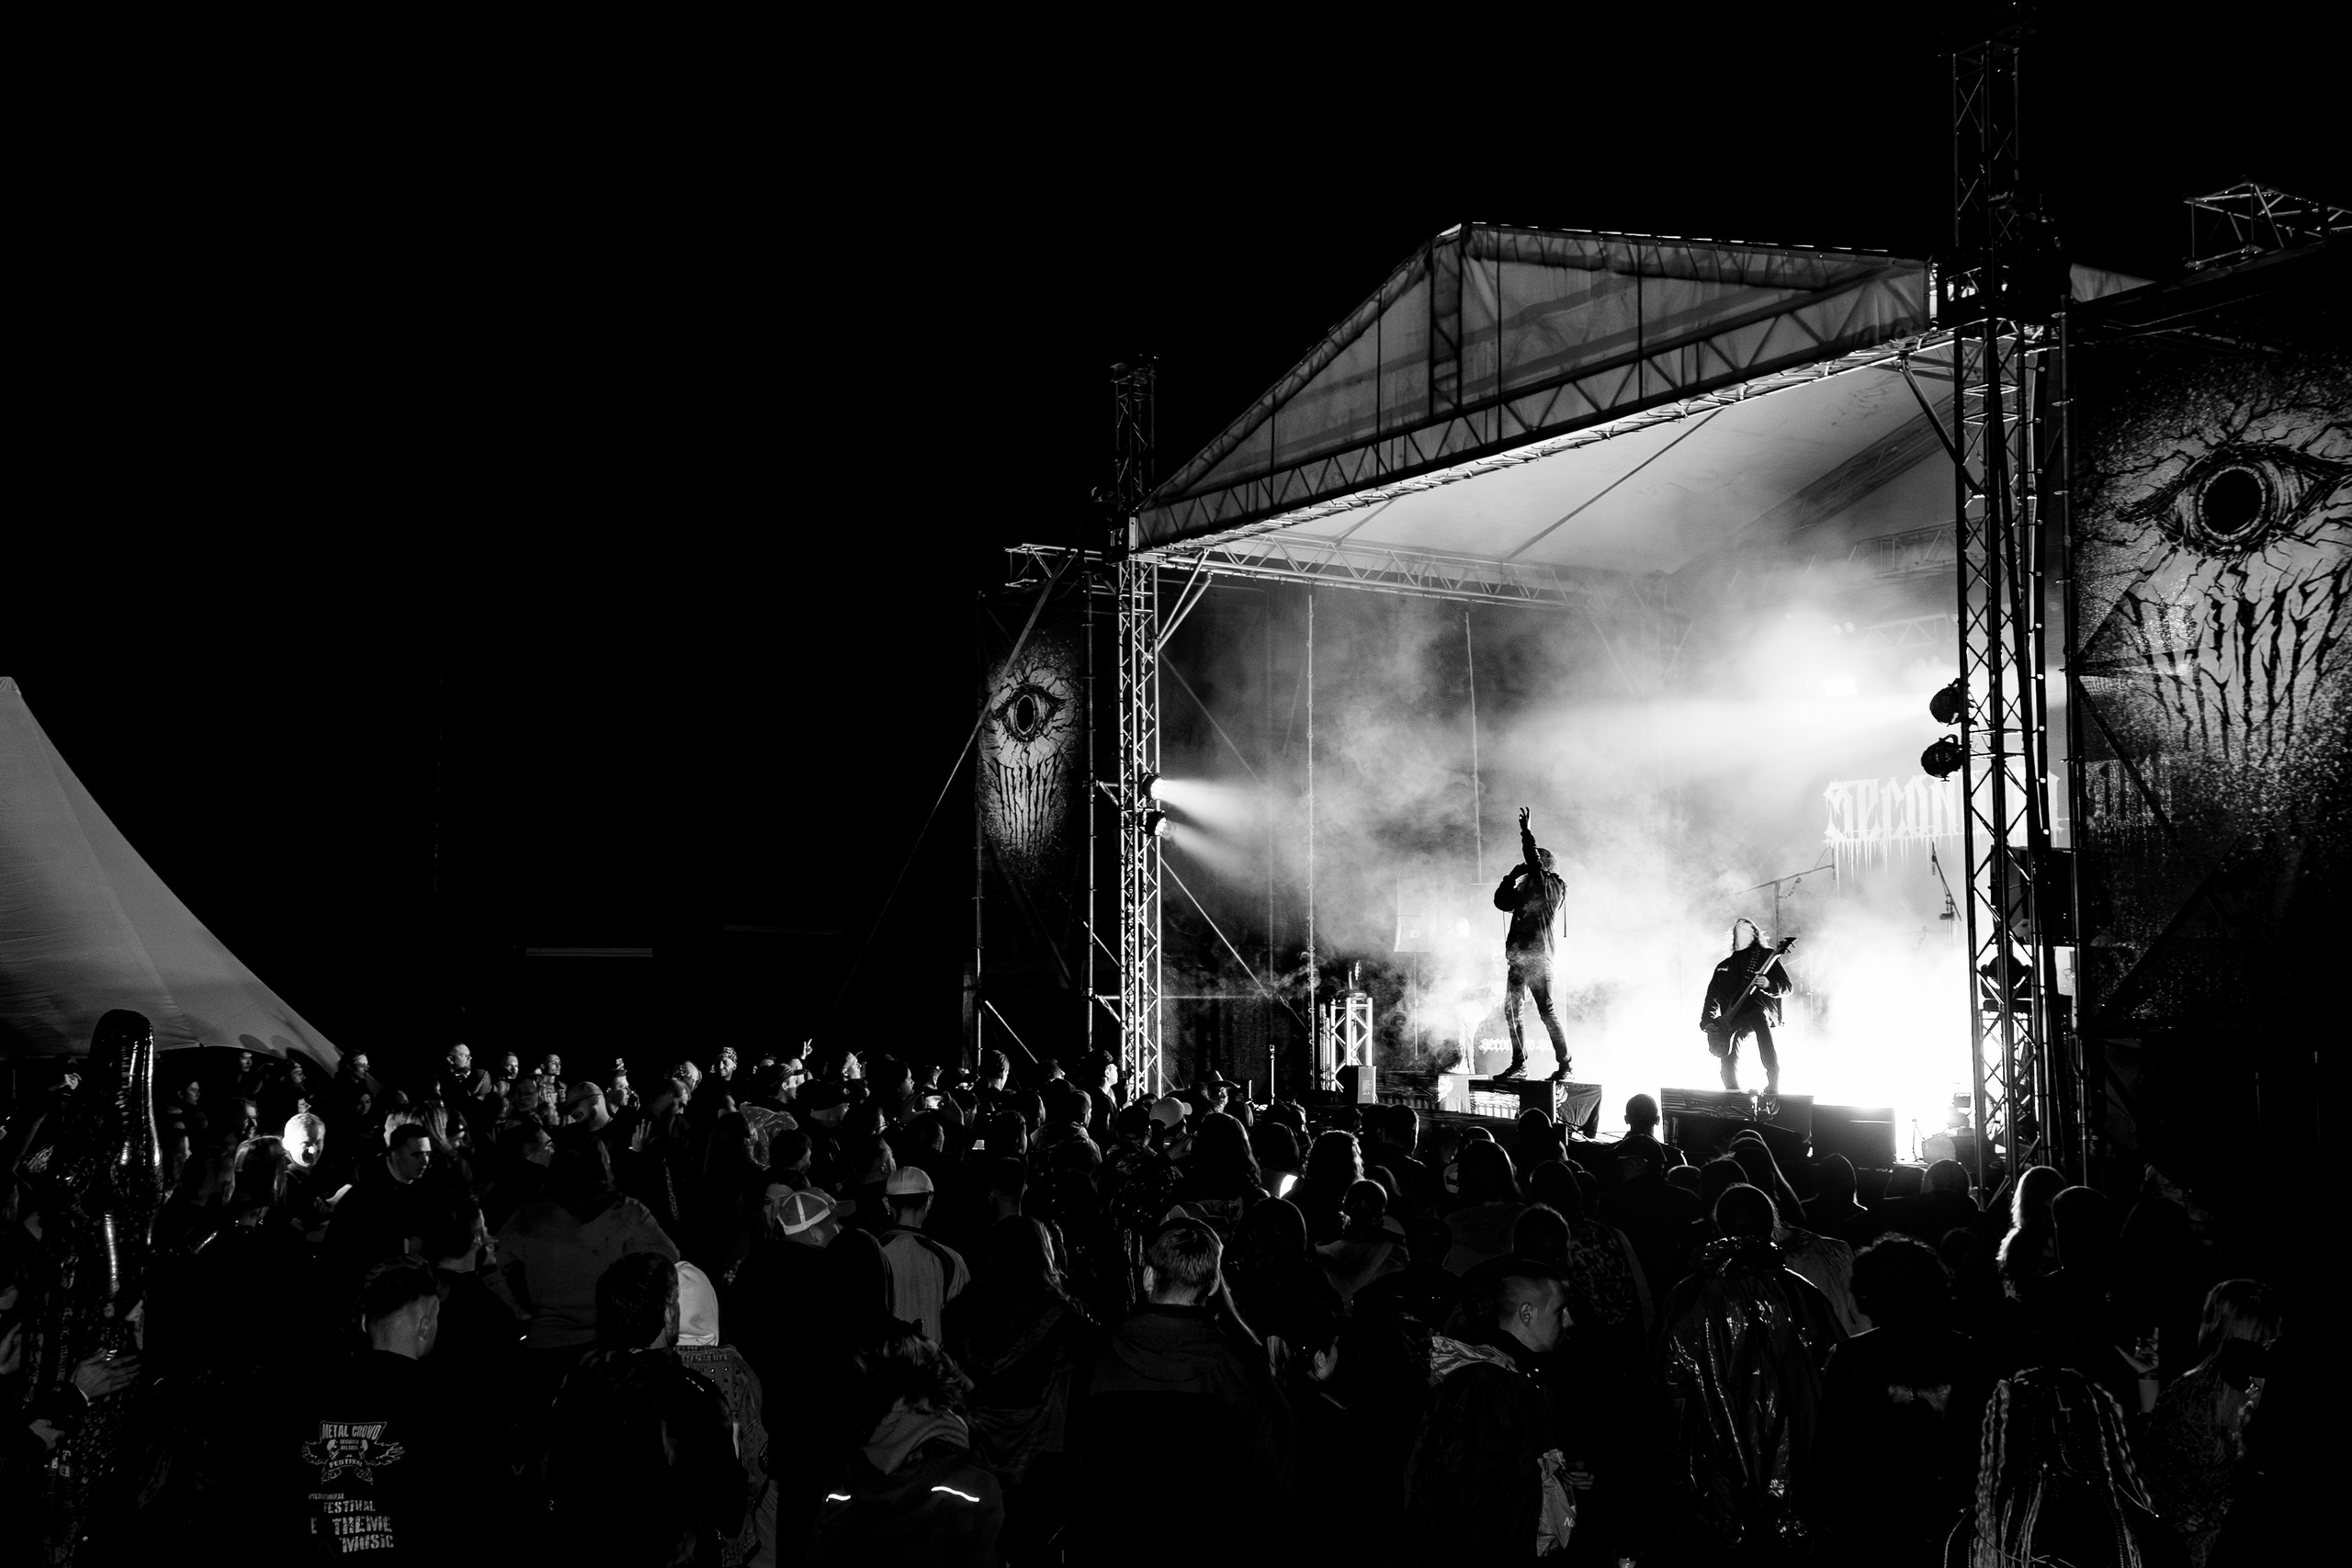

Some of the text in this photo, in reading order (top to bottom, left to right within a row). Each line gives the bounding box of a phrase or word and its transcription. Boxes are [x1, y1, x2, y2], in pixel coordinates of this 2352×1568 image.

[322, 1424, 381, 1440] METAL CROWD
[329, 1458, 363, 1468] FESTIVAL
